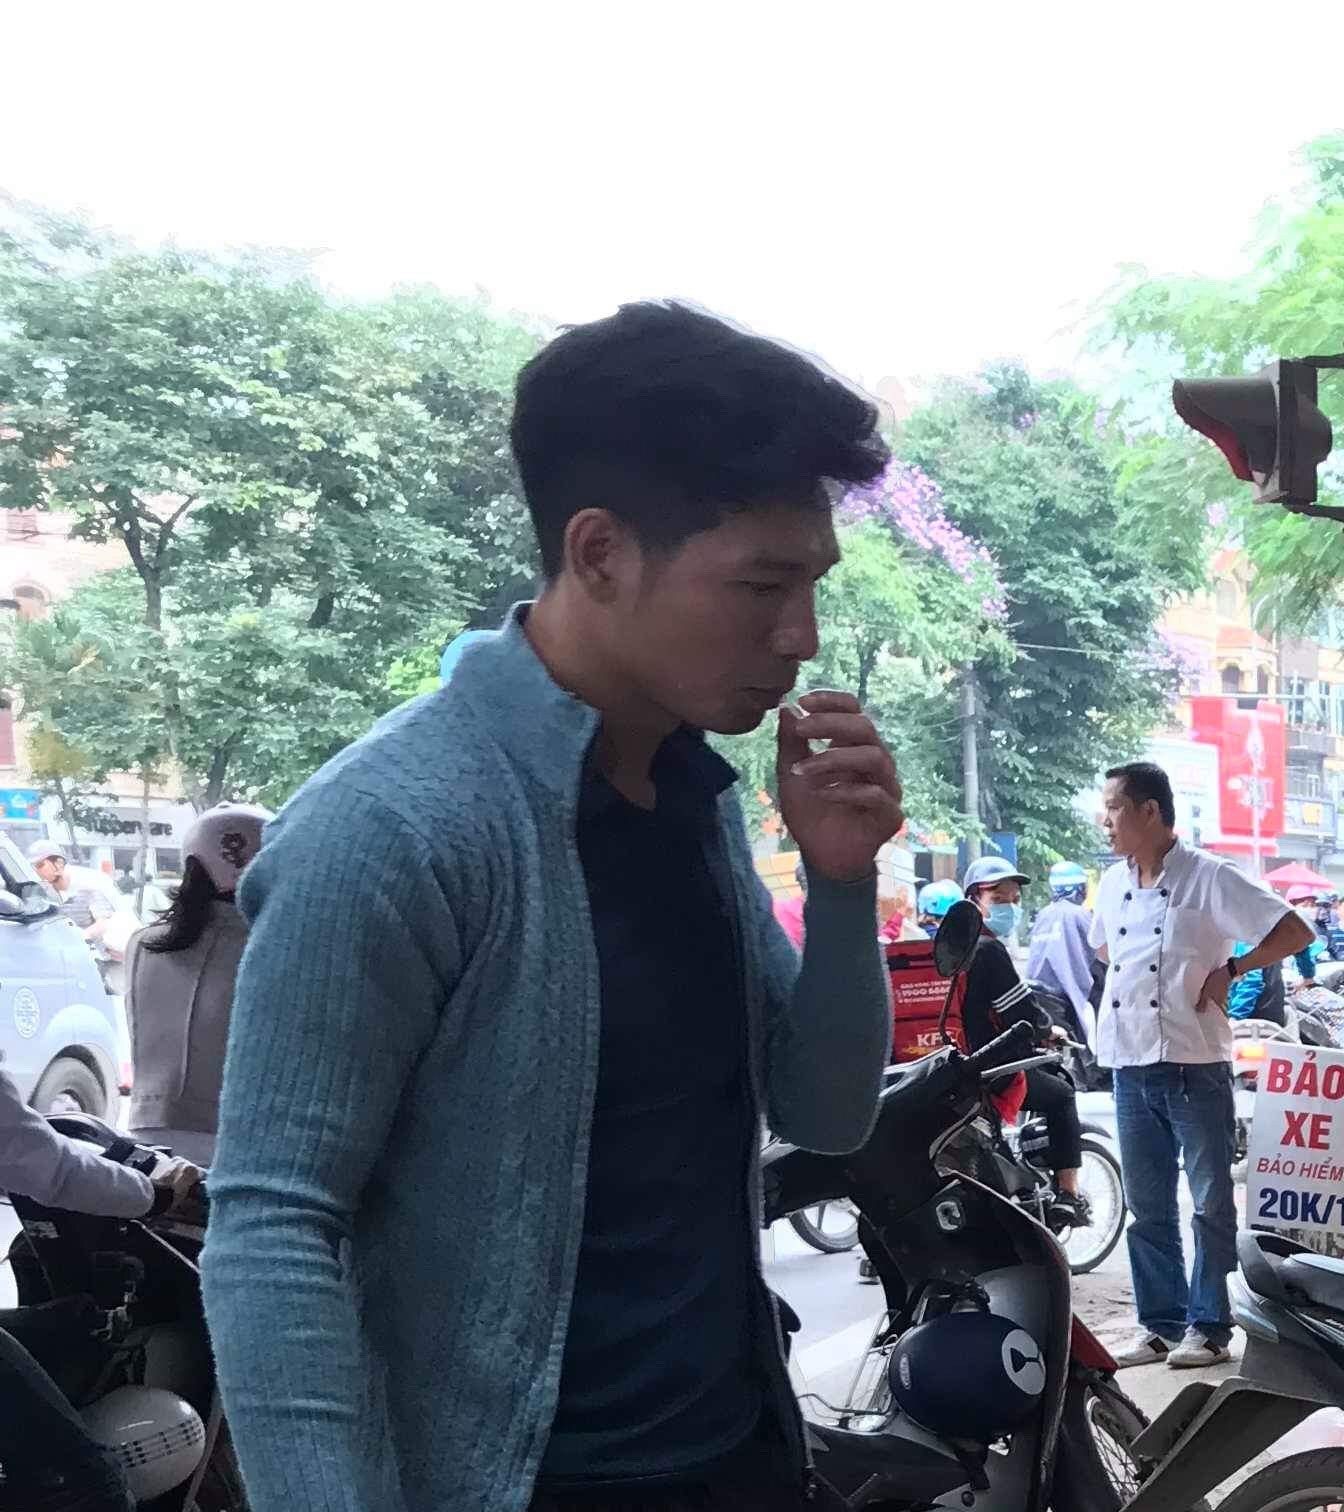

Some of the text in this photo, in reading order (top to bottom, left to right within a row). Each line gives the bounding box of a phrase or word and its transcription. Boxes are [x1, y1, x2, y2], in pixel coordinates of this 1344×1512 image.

[1280, 1110, 1332, 1150] XE
[1256, 1154, 1296, 1176] BẢO
[1299, 1157, 1344, 1182] HIỂM
